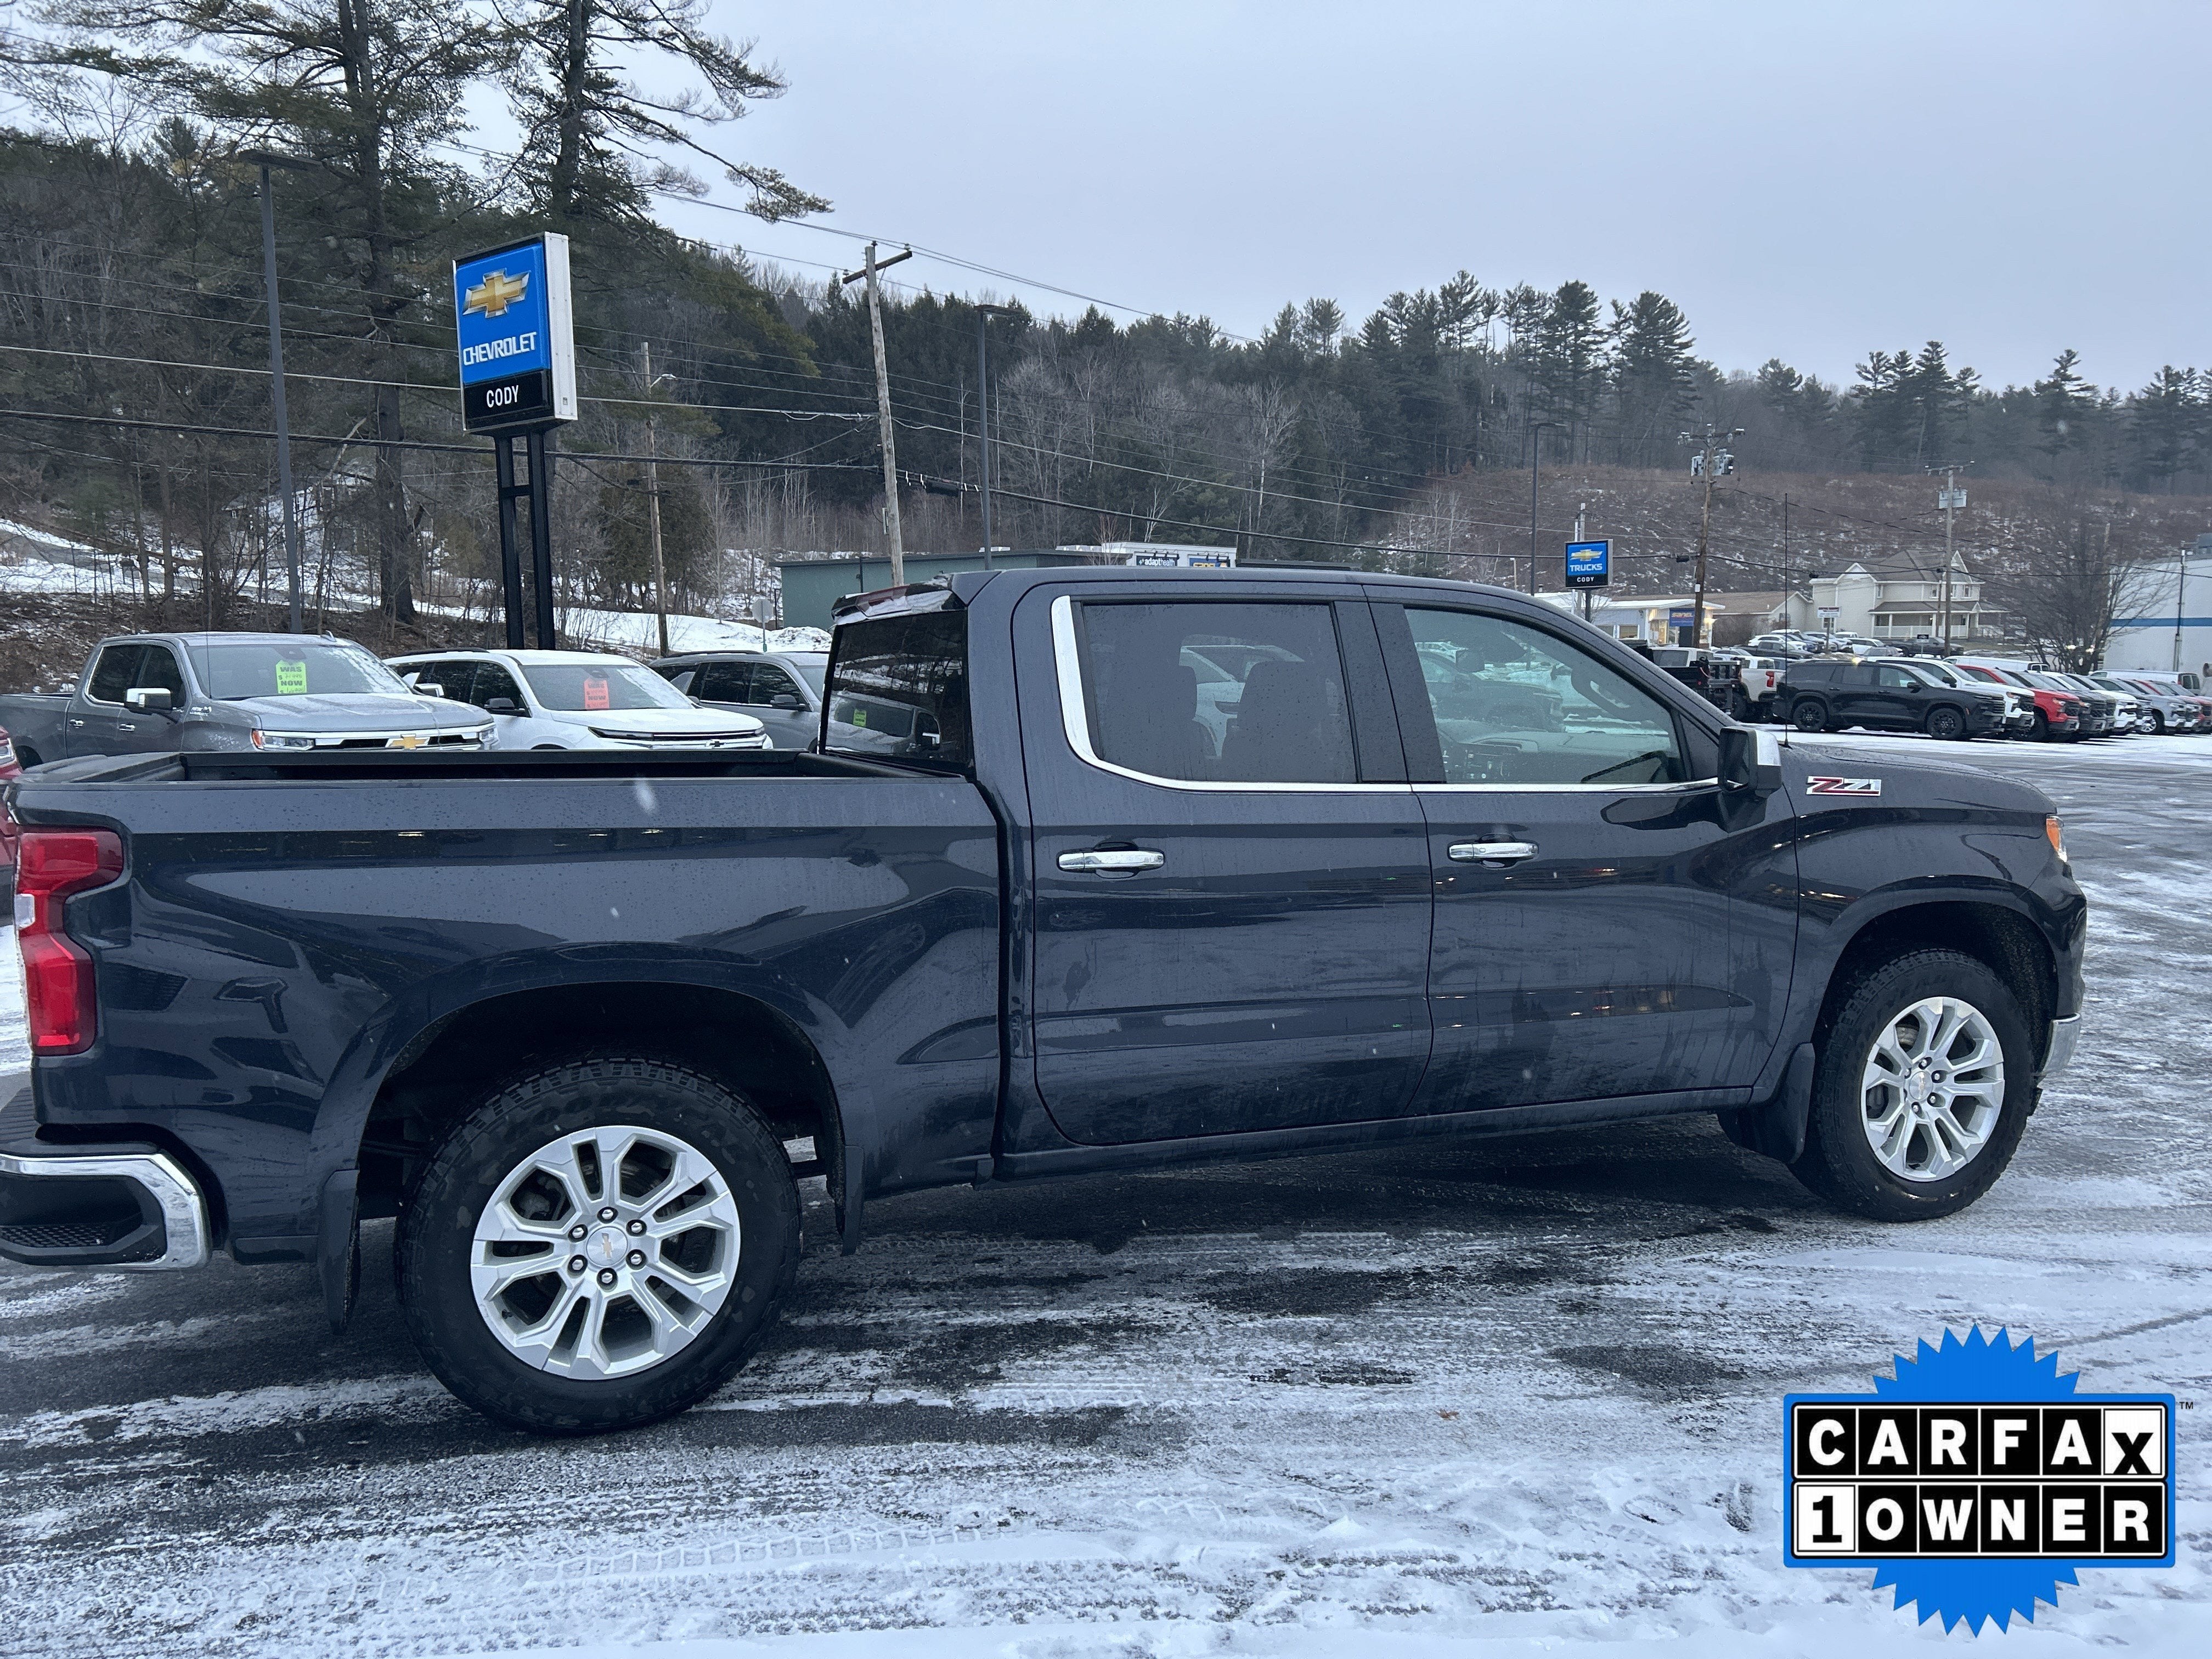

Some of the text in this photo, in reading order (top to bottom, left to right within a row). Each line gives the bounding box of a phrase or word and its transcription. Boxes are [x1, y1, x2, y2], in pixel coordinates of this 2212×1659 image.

[463, 331, 537, 366] CHEVROLET
[486, 385, 519, 408] CODY
[1570, 563, 1602, 572] TRUCKS
[1806, 776, 1882, 796] Z71
